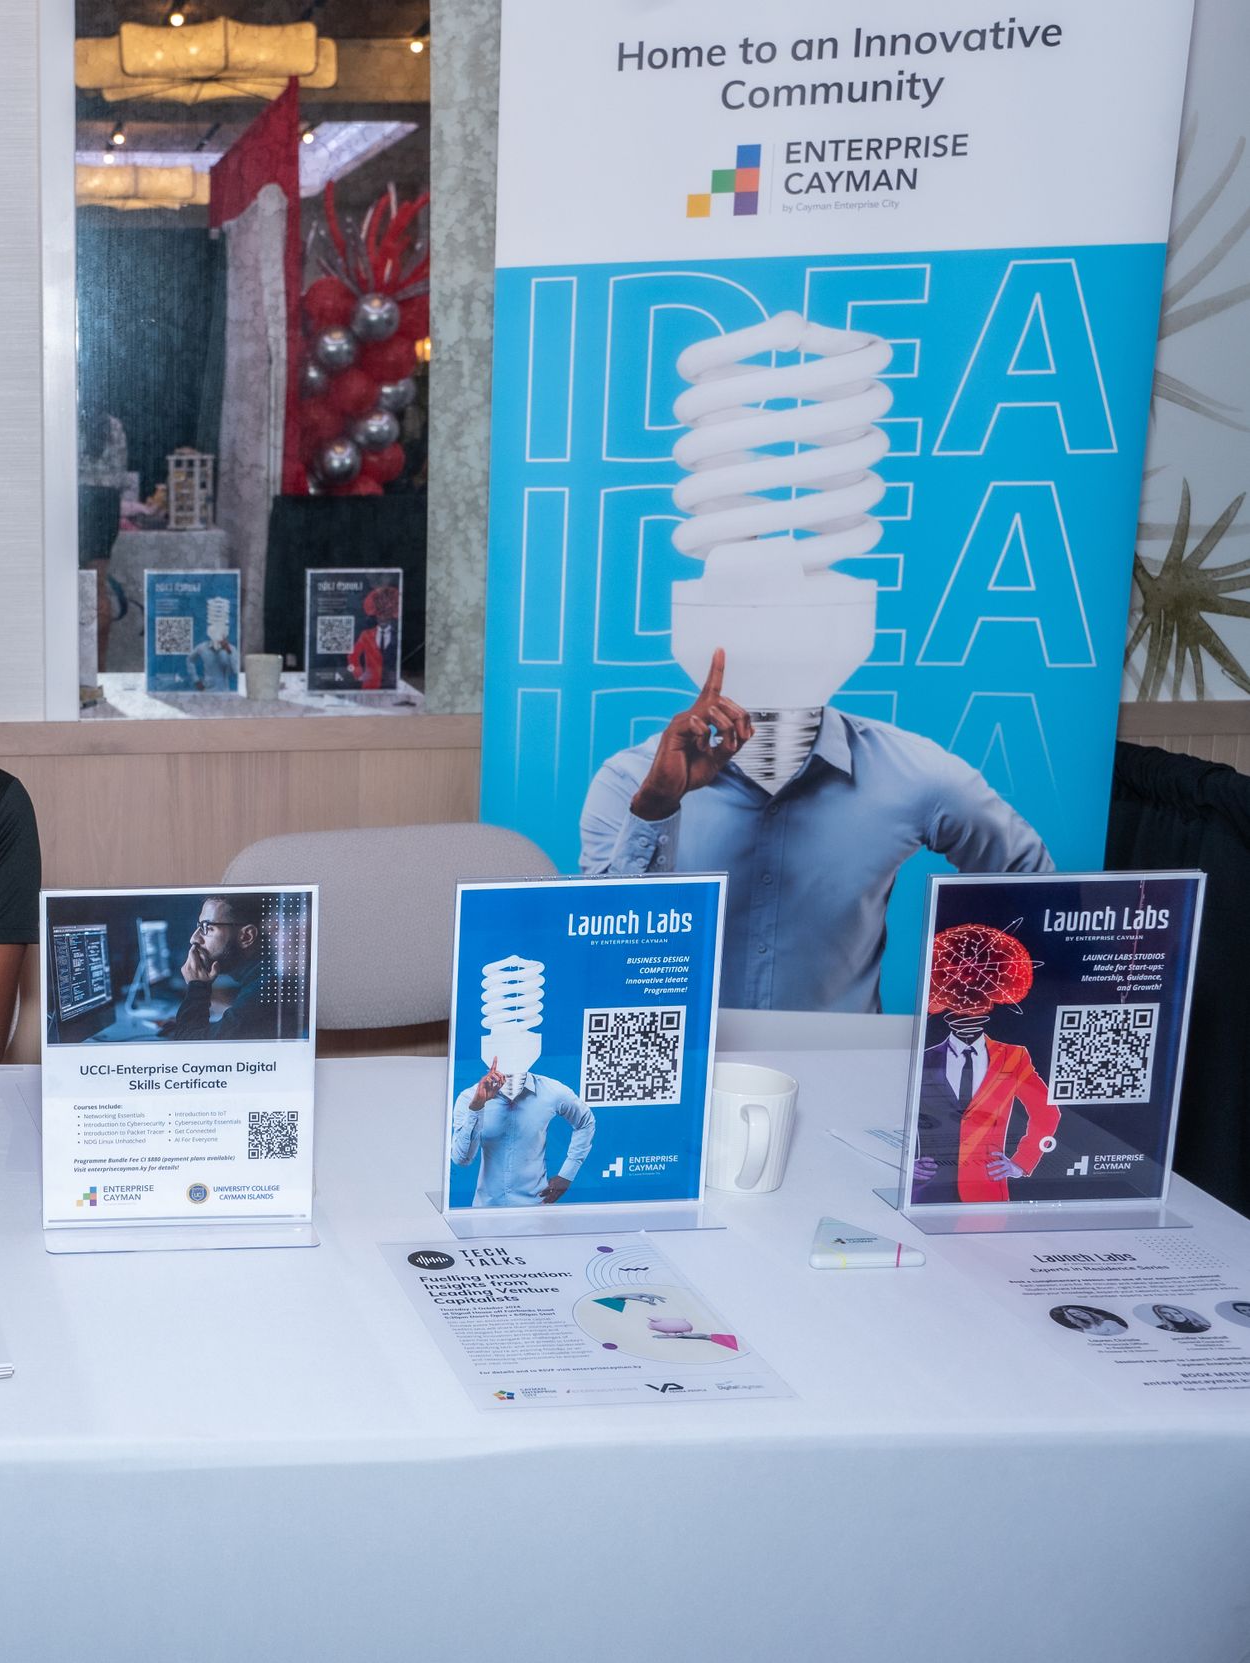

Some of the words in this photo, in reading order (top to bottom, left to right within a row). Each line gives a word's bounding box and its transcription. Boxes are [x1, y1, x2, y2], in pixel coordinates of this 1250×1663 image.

[617, 40, 727, 72] Home
[739, 37, 778, 66] to
[791, 36, 838, 62] an
[853, 17, 1063, 59] Innovative
[720, 70, 945, 109] Community
[784, 134, 969, 164] ENTERPRISE
[784, 168, 918, 195] CAYMAN
[782, 203, 792, 213] by
[796, 202, 832, 212] Cayman
[834, 201, 880, 212] Enterprise
[883, 199, 899, 210] City
[568, 910, 639, 937] Launch
[647, 909, 692, 934] Labs
[1043, 906, 1116, 932] Launch
[1123, 905, 1169, 930] Labs
[639, 966, 689, 974] COMPETITION
[1116, 963, 1127, 972] for
[1128, 963, 1164, 972] Start-ups:
[626, 977, 663, 985] Innovative
[1081, 974, 1125, 983] Mentorship,
[1127, 973, 1162, 982] Guidance,
[643, 986, 688, 995] Programme!
[1133, 983, 1162, 992] Growth!
[80, 1063, 178, 1076] UCCI-Enterprise
[182, 1062, 232, 1076] Cayman
[236, 1061, 277, 1074] Digital
[129, 1079, 161, 1091] Skills
[164, 1078, 228, 1090] Certificate
[629, 1154, 678, 1164] ENTERPRISE
[1094, 1154, 1144, 1162] ENTERPRISE
[628, 1163, 666, 1172] CAYMAN
[1093, 1162, 1132, 1170] CAYMAN
[103, 1185, 154, 1193] ENTERPRISE
[459, 1248, 508, 1258] TECH
[1033, 1253, 1096, 1264] Launch
[1093, 1252, 1137, 1262] Labs
[466, 1256, 527, 1268] TALKS
[419, 1275, 481, 1284] Fuelling
[484, 1271, 572, 1281] Innovation:
[424, 1282, 486, 1291] Insights
[490, 1279, 528, 1287] from
[428, 1289, 493, 1298] Leading
[496, 1286, 560, 1295] Venture
[434, 1295, 520, 1306] Capitalists
